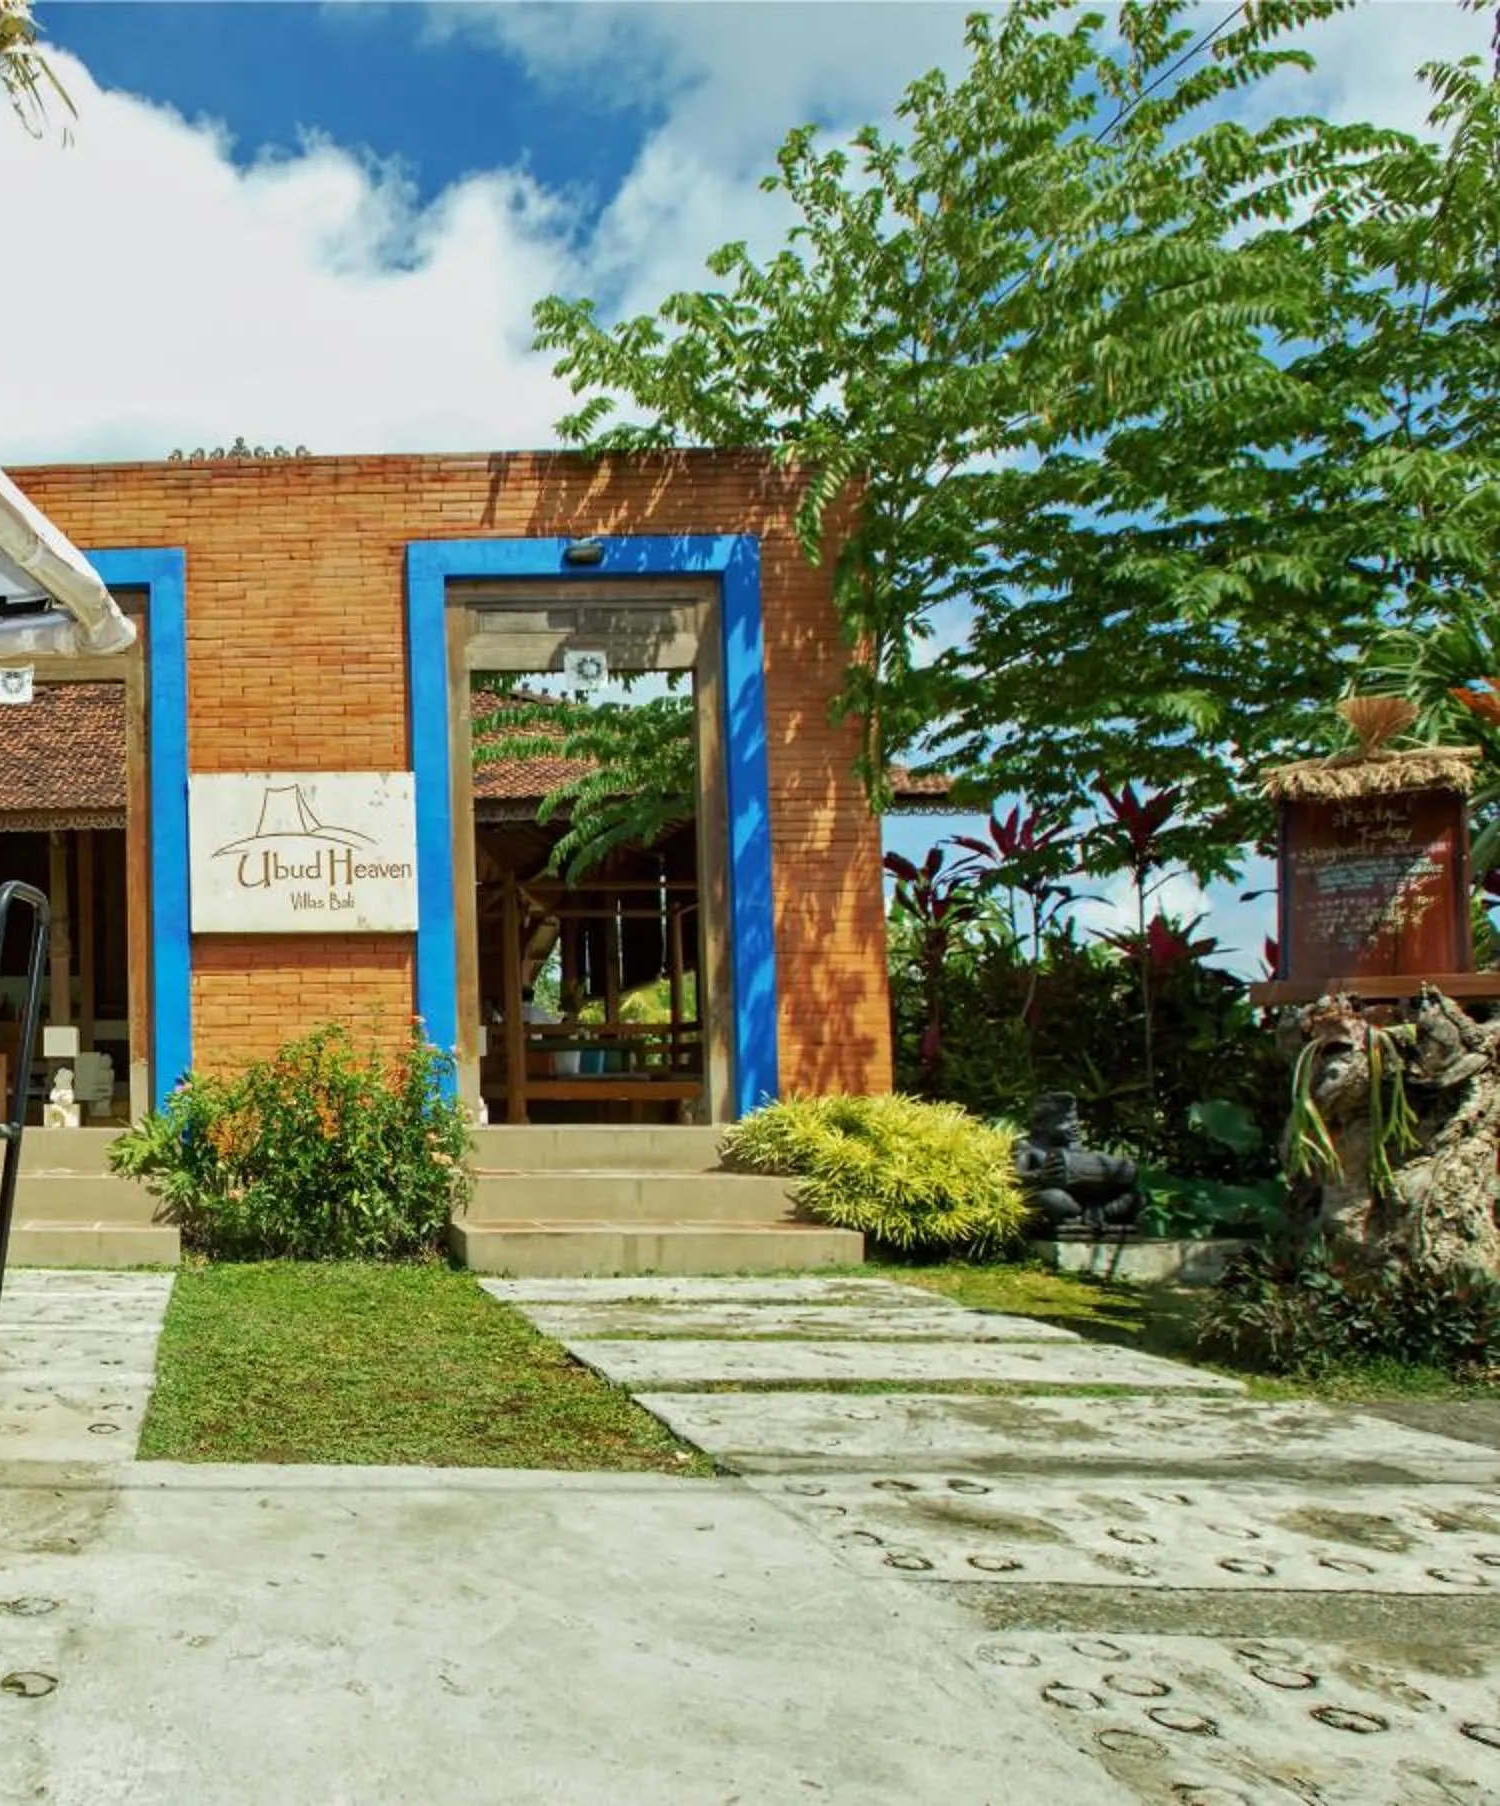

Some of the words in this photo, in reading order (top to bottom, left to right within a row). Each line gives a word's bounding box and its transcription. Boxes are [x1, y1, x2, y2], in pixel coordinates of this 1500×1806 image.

[238, 850, 322, 888] Ubud
[329, 848, 412, 886] Heaven
[290, 892, 325, 911] Villas
[329, 893, 355, 911] Bali
